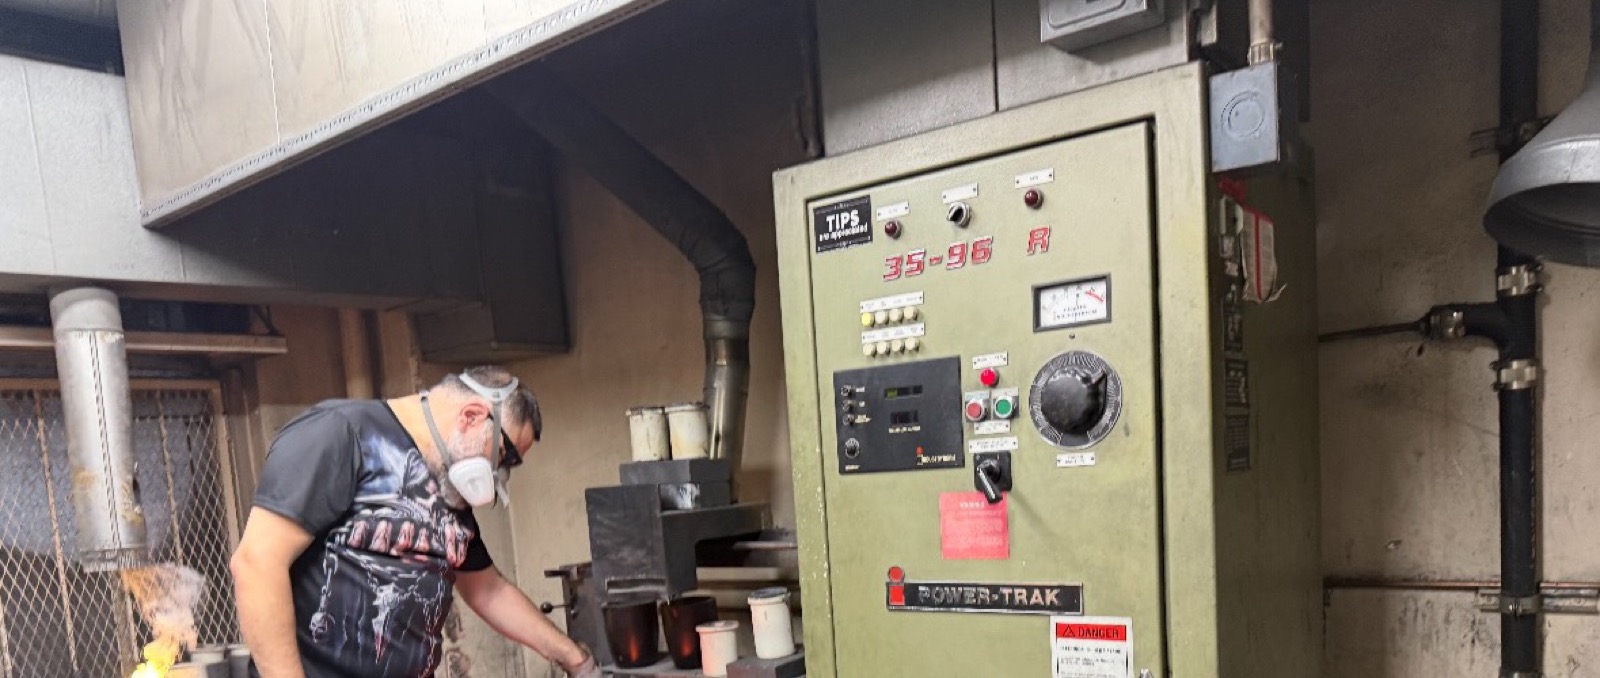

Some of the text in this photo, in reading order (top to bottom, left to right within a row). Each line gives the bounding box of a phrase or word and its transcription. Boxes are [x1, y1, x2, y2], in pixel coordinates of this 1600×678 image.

[826, 209, 860, 233] TIPS
[883, 225, 1051, 282] 35-96 R
[917, 585, 1062, 607] POWER-TRAK
[1077, 625, 1120, 639] DANGER
